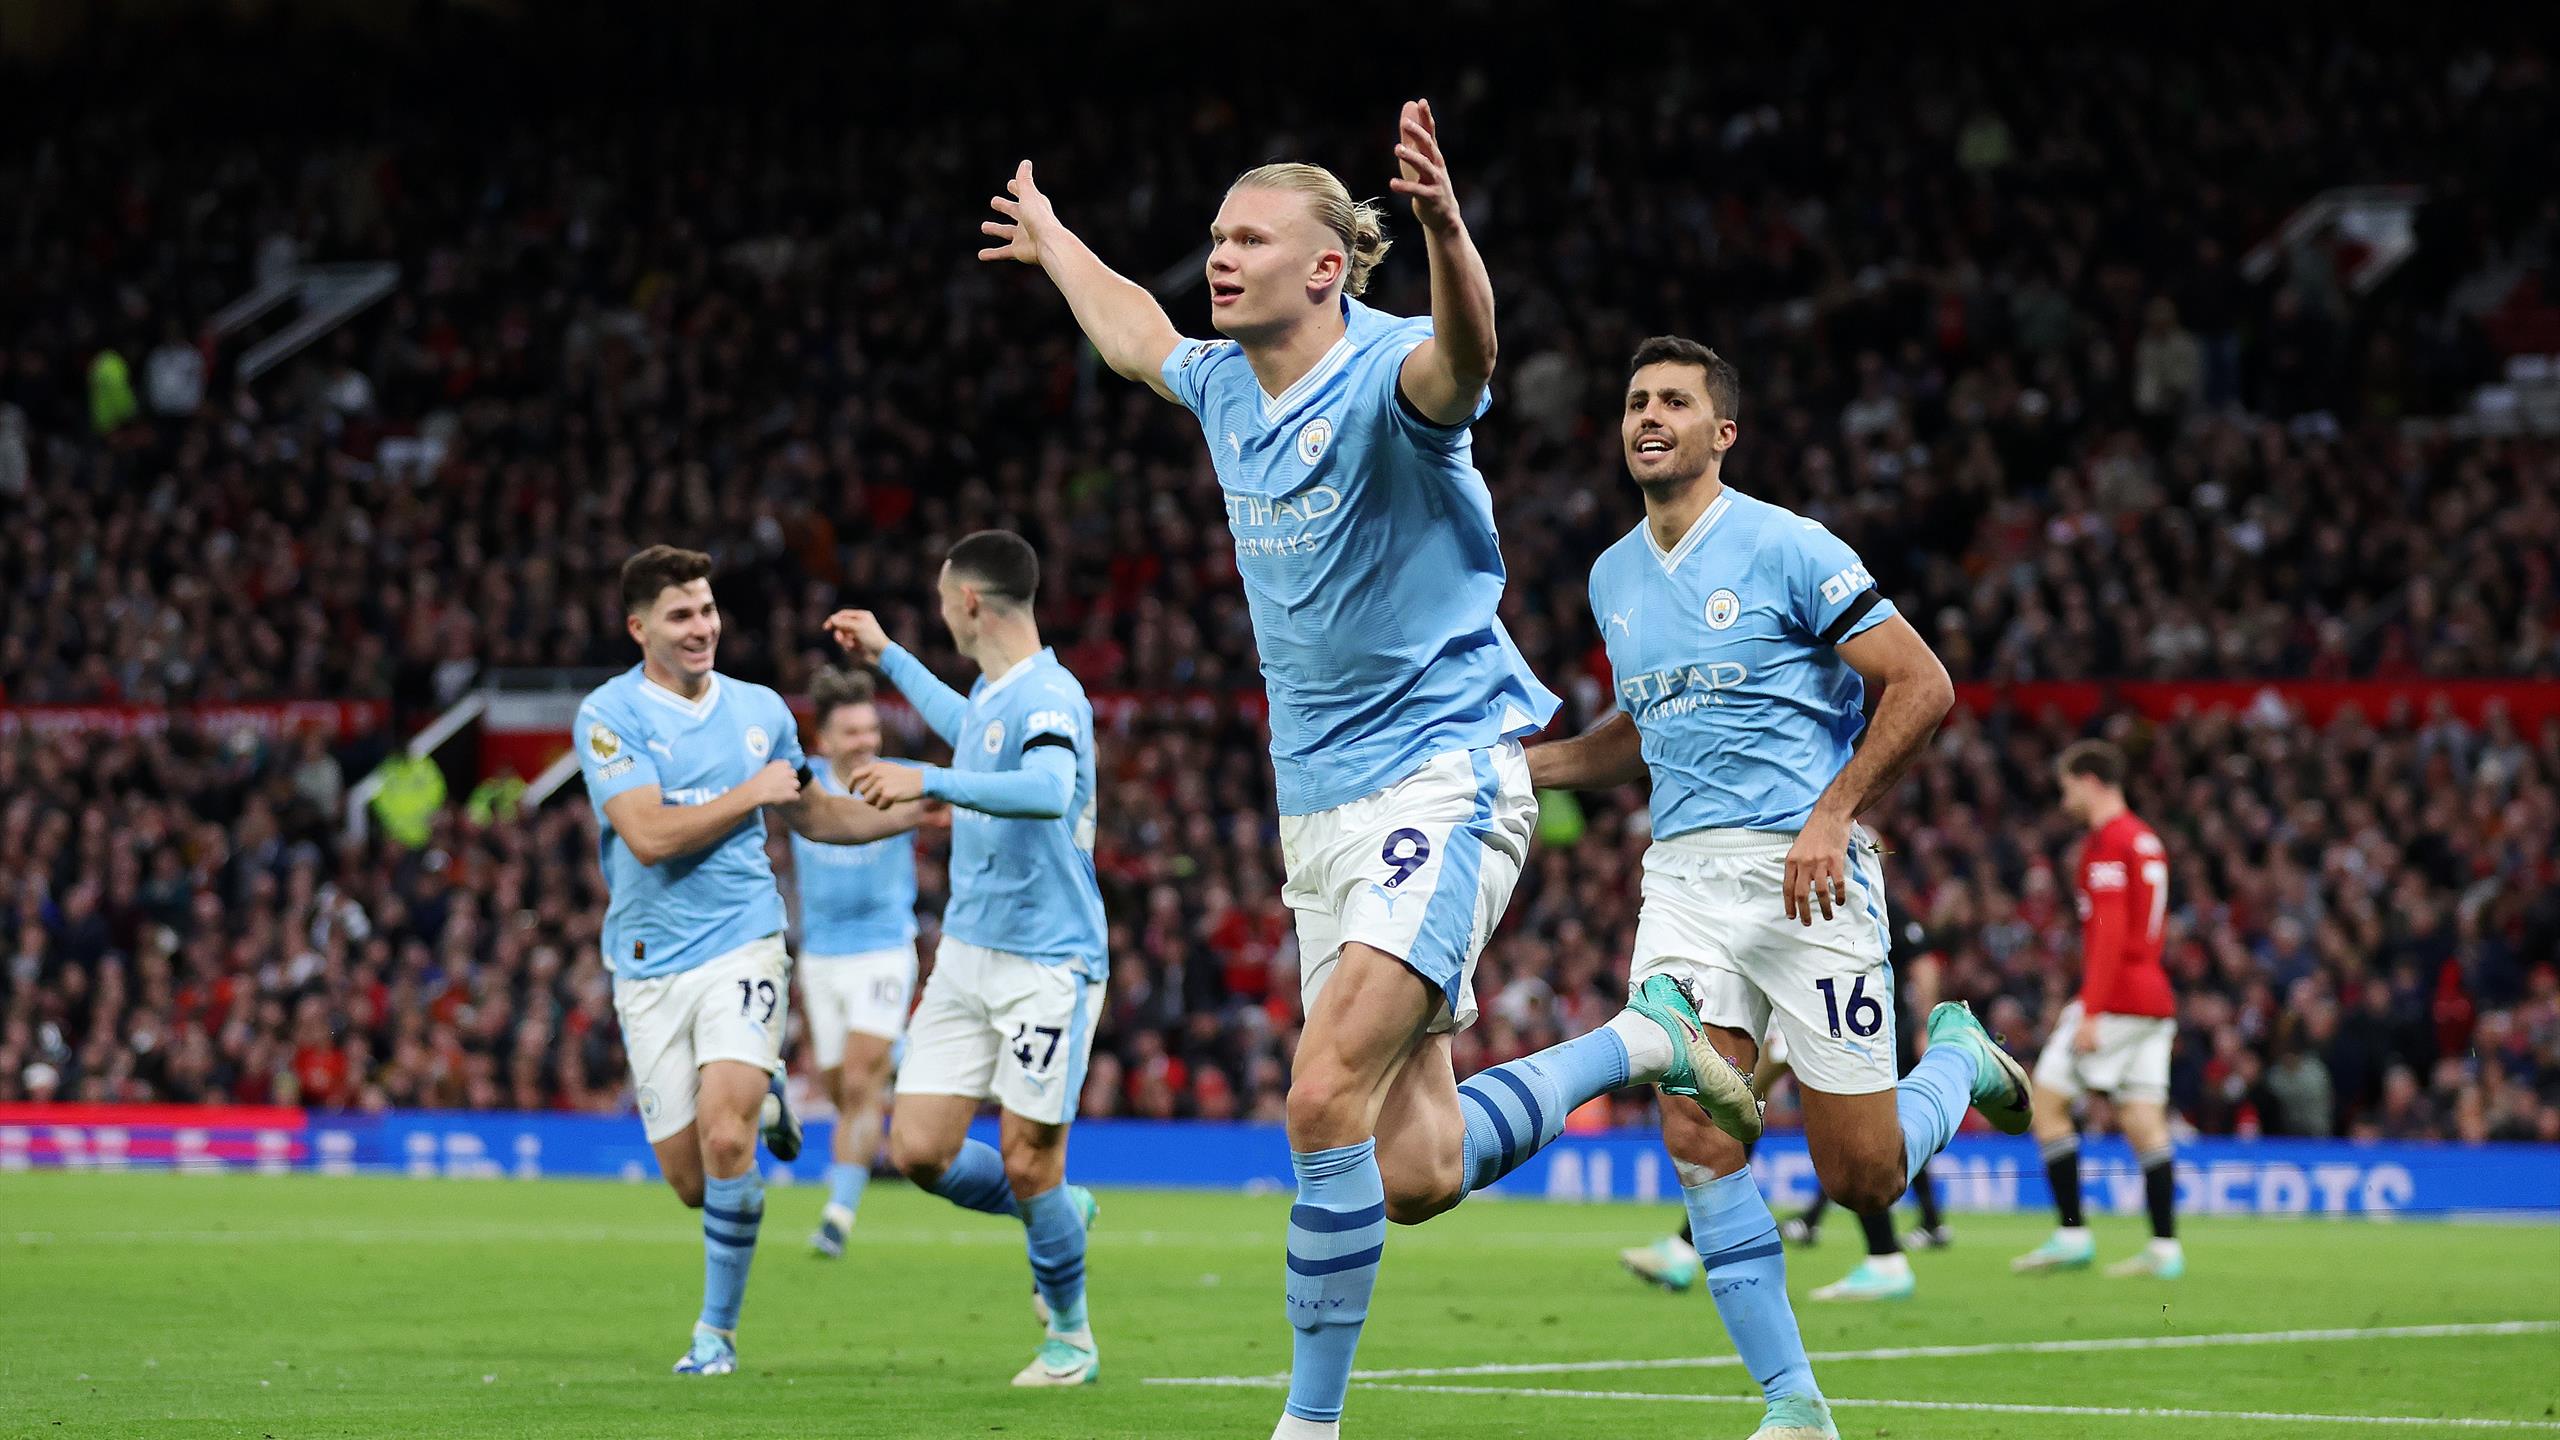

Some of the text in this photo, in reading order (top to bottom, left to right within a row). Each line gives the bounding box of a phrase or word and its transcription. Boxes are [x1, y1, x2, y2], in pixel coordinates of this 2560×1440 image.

[1620, 661, 1748, 703] ETIHAD
[1382, 827, 1430, 888] 9
[2141, 860, 2169, 943] 7
[738, 978, 776, 1023] 19
[1816, 975, 1882, 1038] 16
[1012, 1022, 1064, 1073] 47
[1287, 1294, 1346, 1310] CITY
